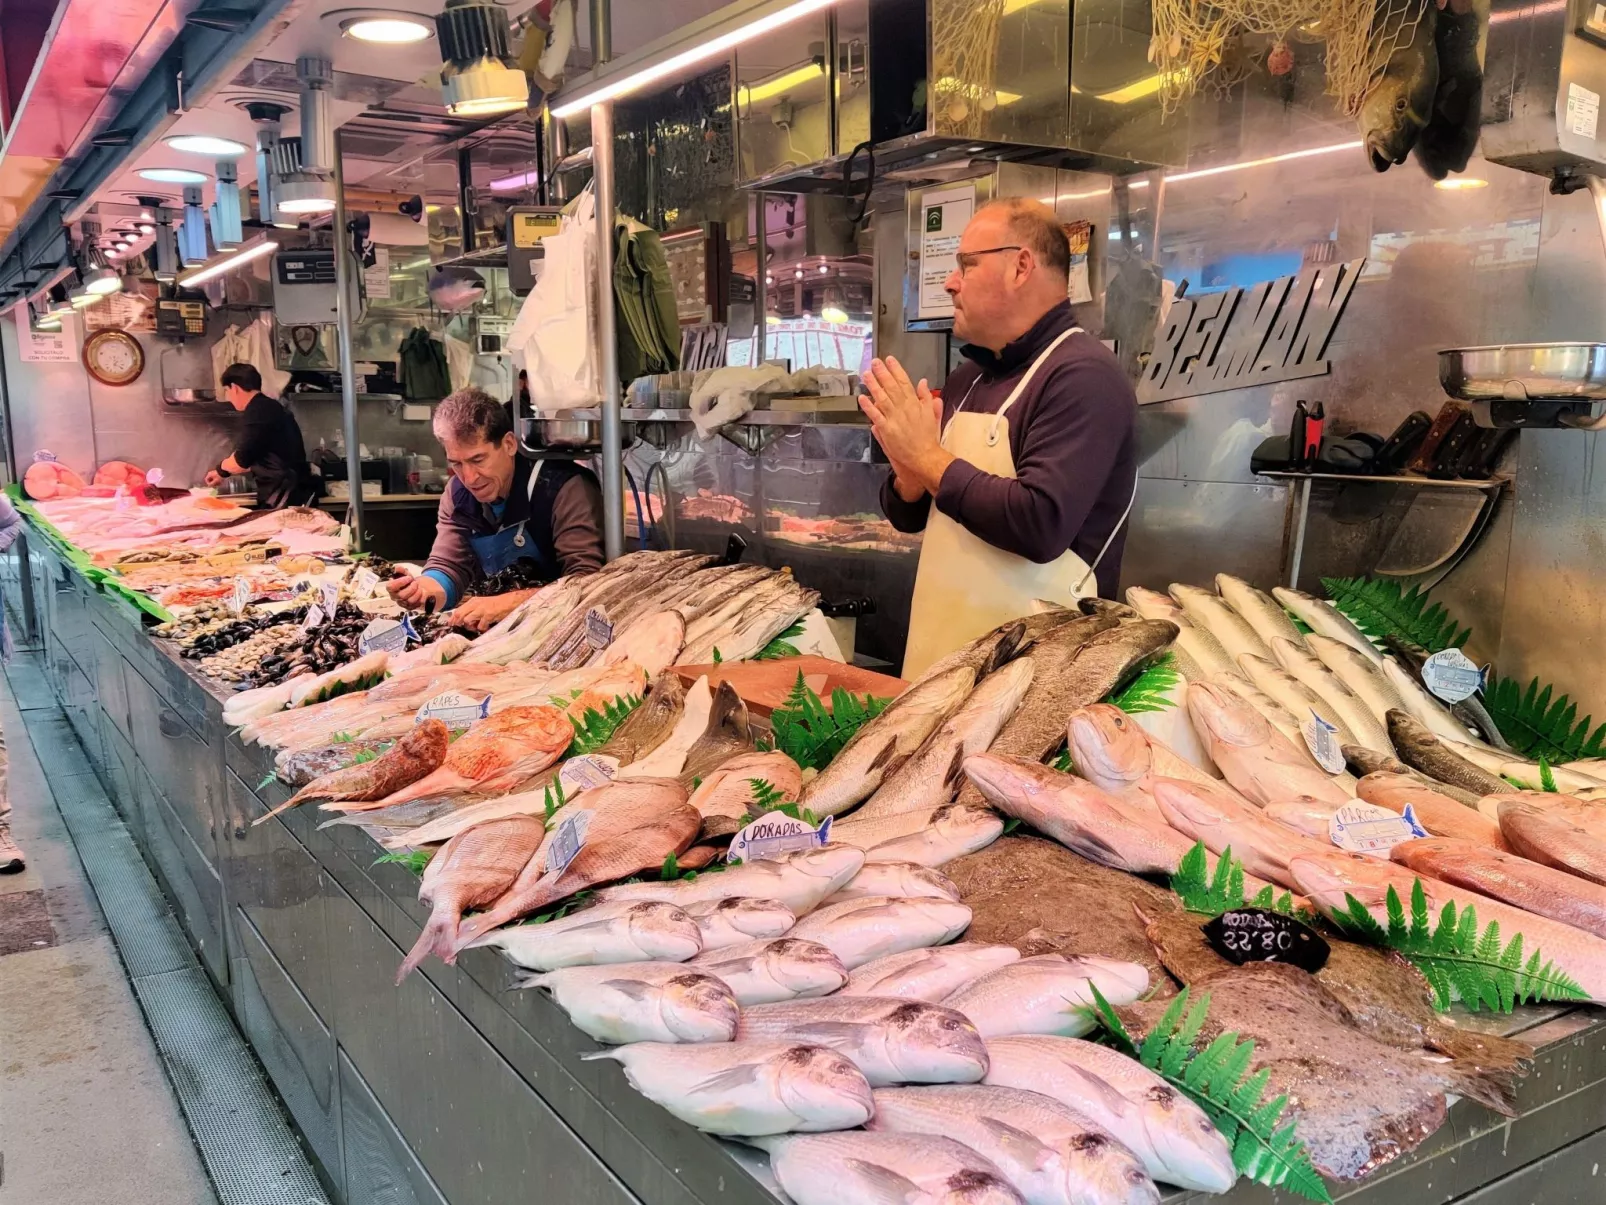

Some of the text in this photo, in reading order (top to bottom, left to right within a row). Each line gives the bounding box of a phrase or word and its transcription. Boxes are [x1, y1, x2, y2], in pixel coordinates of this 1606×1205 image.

[1137, 257, 1367, 402] BELMAN
[431, 695, 460, 708] RAPES
[751, 822, 803, 840] DORADAS
[1222, 930, 1293, 951] 22'80
